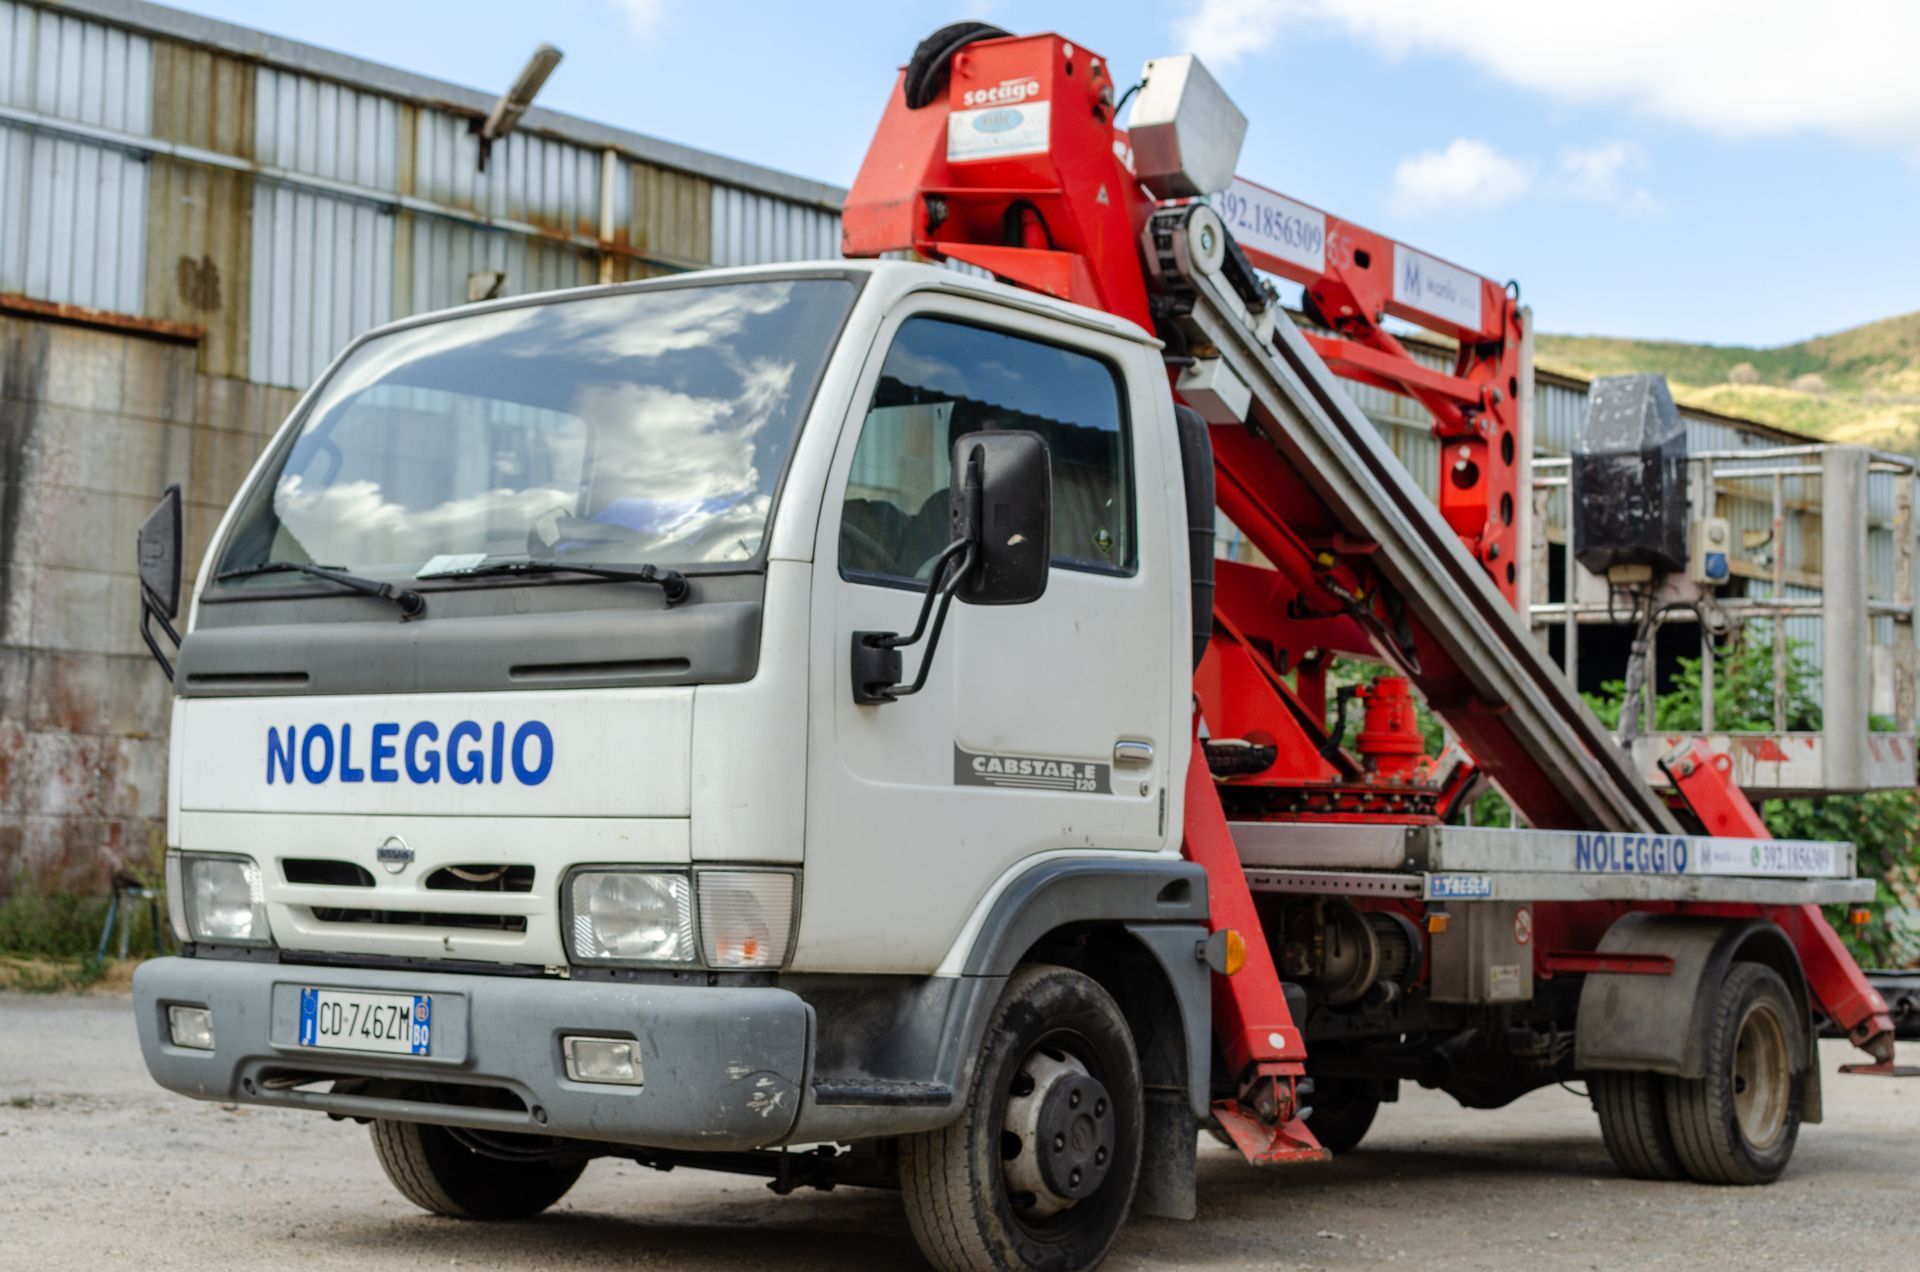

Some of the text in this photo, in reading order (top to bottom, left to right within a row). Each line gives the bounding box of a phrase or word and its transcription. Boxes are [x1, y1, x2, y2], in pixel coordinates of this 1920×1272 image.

[963, 80, 1041, 106] socage
[266, 720, 554, 786] NOLEGGIO
[972, 757, 1096, 778] CABSTAR.E
[1075, 780, 1096, 791] 120
[1576, 834, 1688, 875] NOLEGGIO
